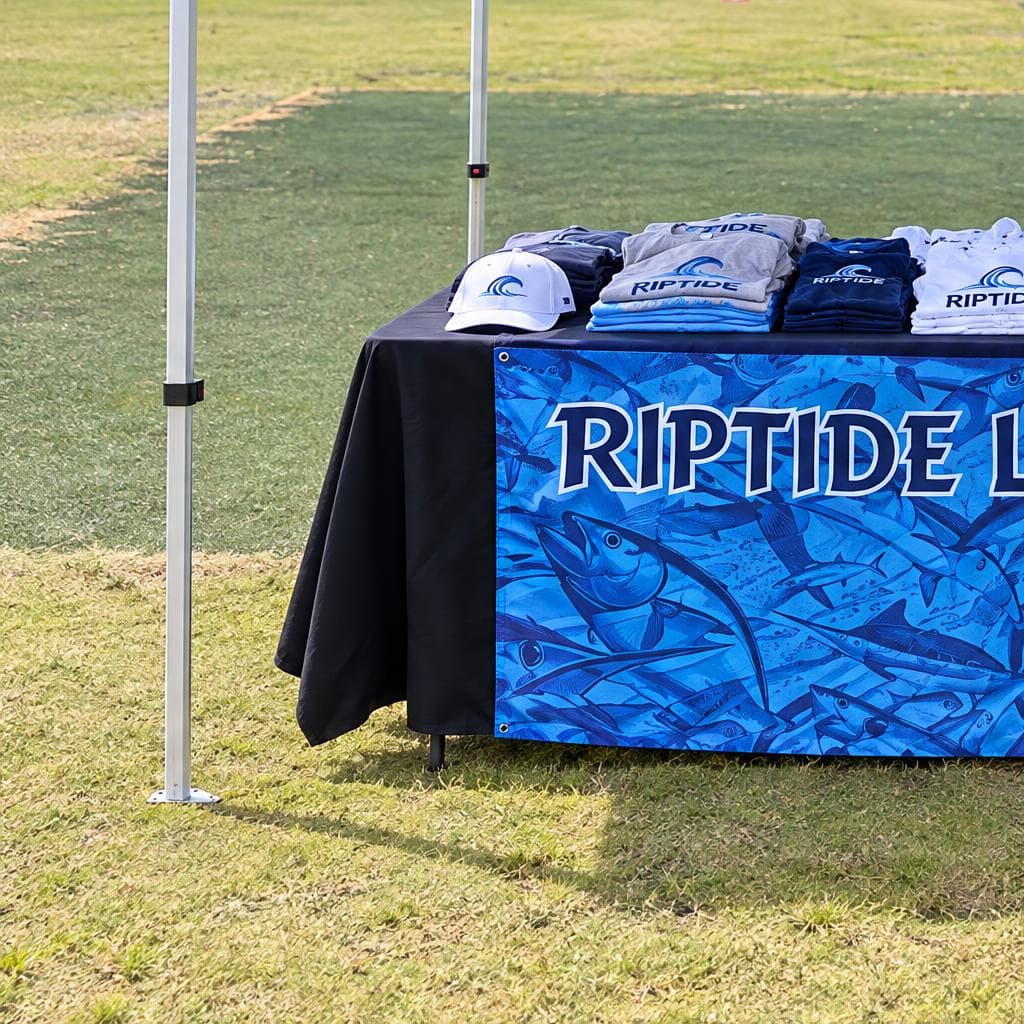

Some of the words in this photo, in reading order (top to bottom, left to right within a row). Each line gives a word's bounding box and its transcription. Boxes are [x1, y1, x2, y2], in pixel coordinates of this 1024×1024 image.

[630, 279, 742, 296] RIPTIDE
[812, 276, 887, 285] RIPTIDE
[546, 401, 964, 499] RIPTIDE
